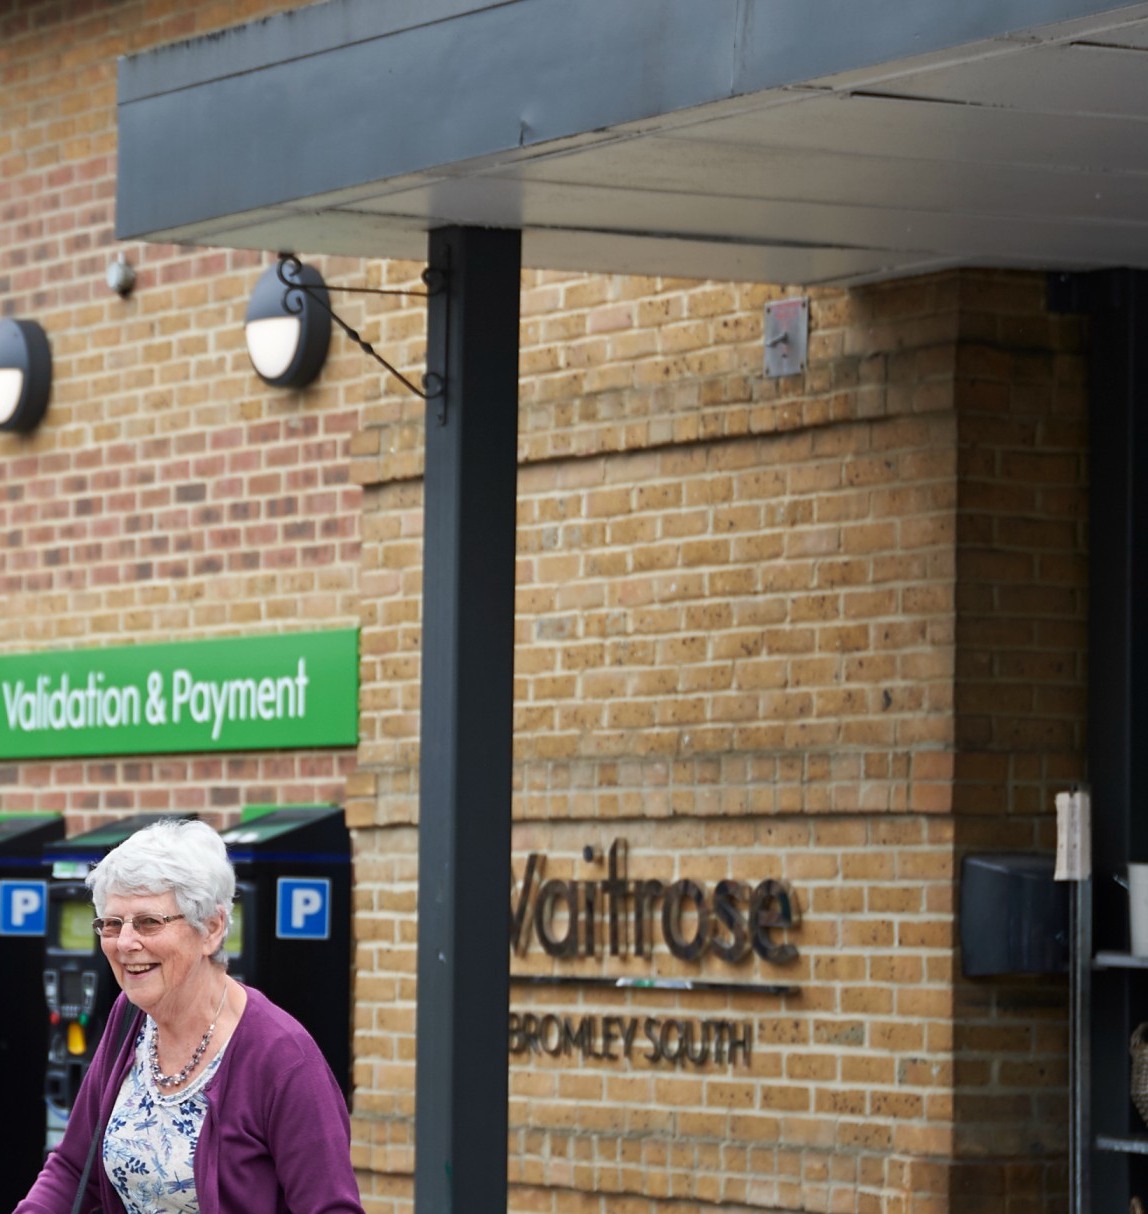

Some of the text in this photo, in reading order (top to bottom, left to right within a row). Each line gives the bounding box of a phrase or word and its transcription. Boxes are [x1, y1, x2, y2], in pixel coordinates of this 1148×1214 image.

[2, 656, 309, 740] Validation & Payment
[11, 889, 40, 926] P
[291, 888, 322, 929] P
[509, 1012, 752, 1068] BROMLEY SOUTH
